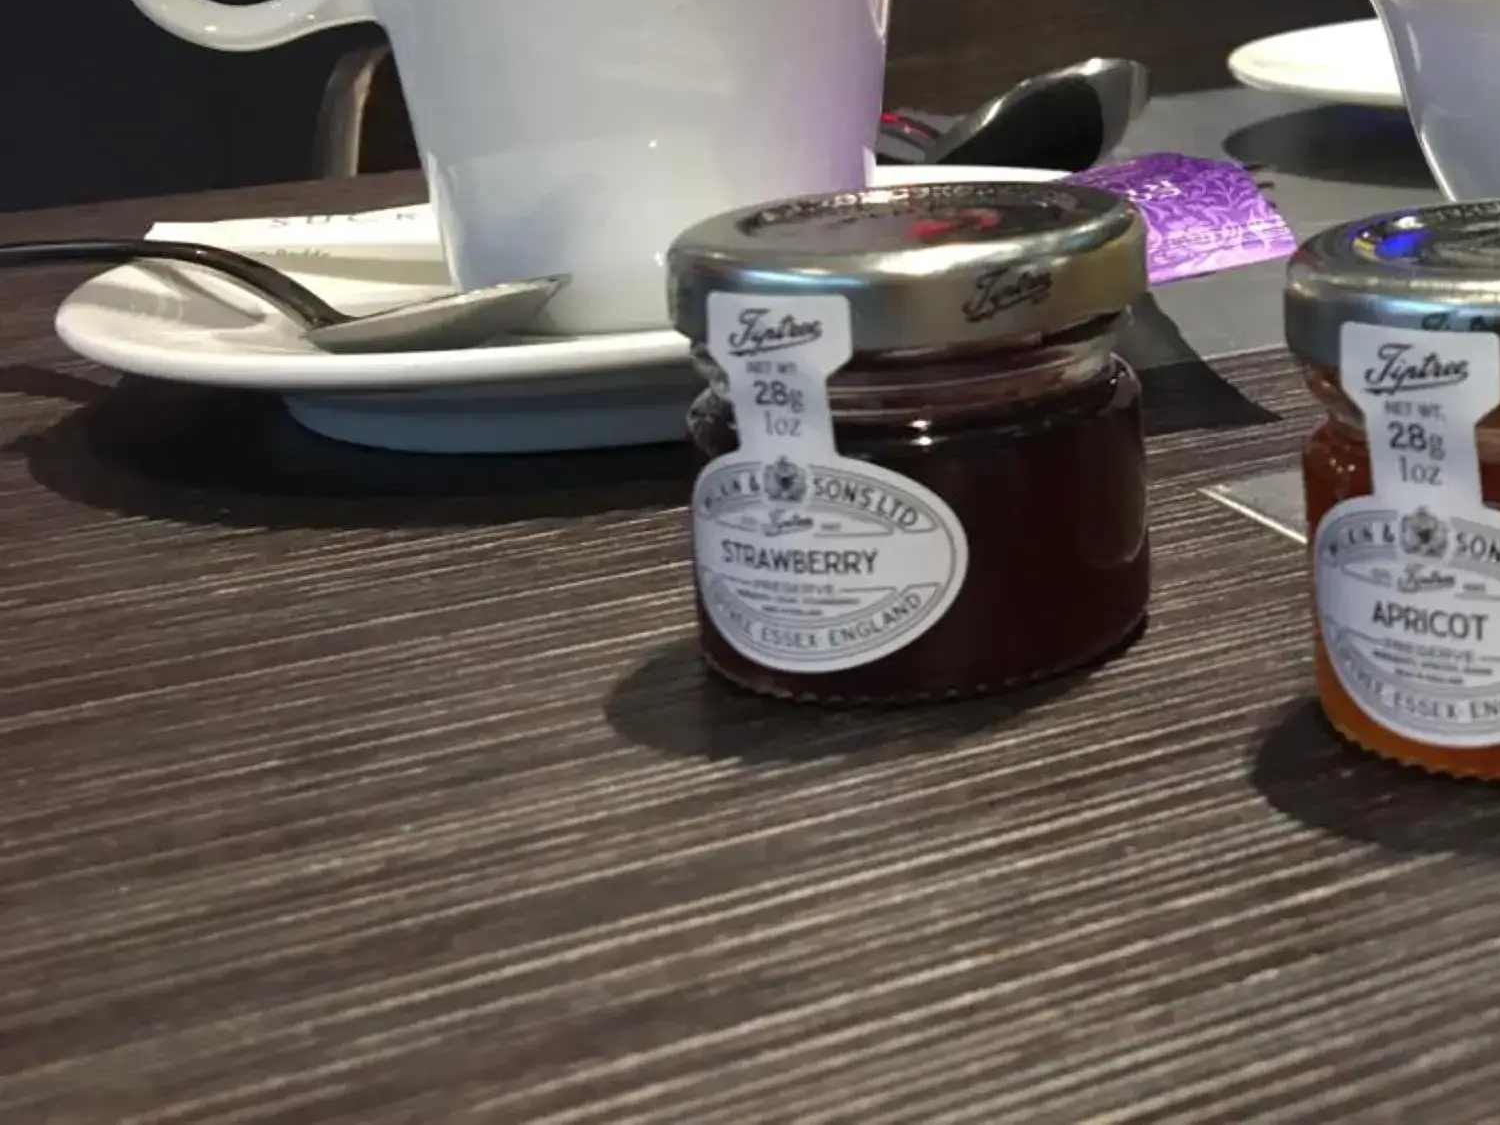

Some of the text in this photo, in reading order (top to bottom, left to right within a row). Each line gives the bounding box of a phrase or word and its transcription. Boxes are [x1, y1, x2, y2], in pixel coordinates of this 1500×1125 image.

[728, 308, 824, 356] Tiptree
[1363, 343, 1469, 395] Tiptree
[753, 380, 805, 414] 28g
[1387, 421, 1446, 461] 28g
[812, 477, 875, 509] SONS
[878, 493, 919, 528] LTD
[721, 539, 878, 575] STRAWBERRY
[760, 627, 818, 648] ESSEX
[828, 592, 922, 647] ENGLAND
[1372, 600, 1489, 641] APRICOT
